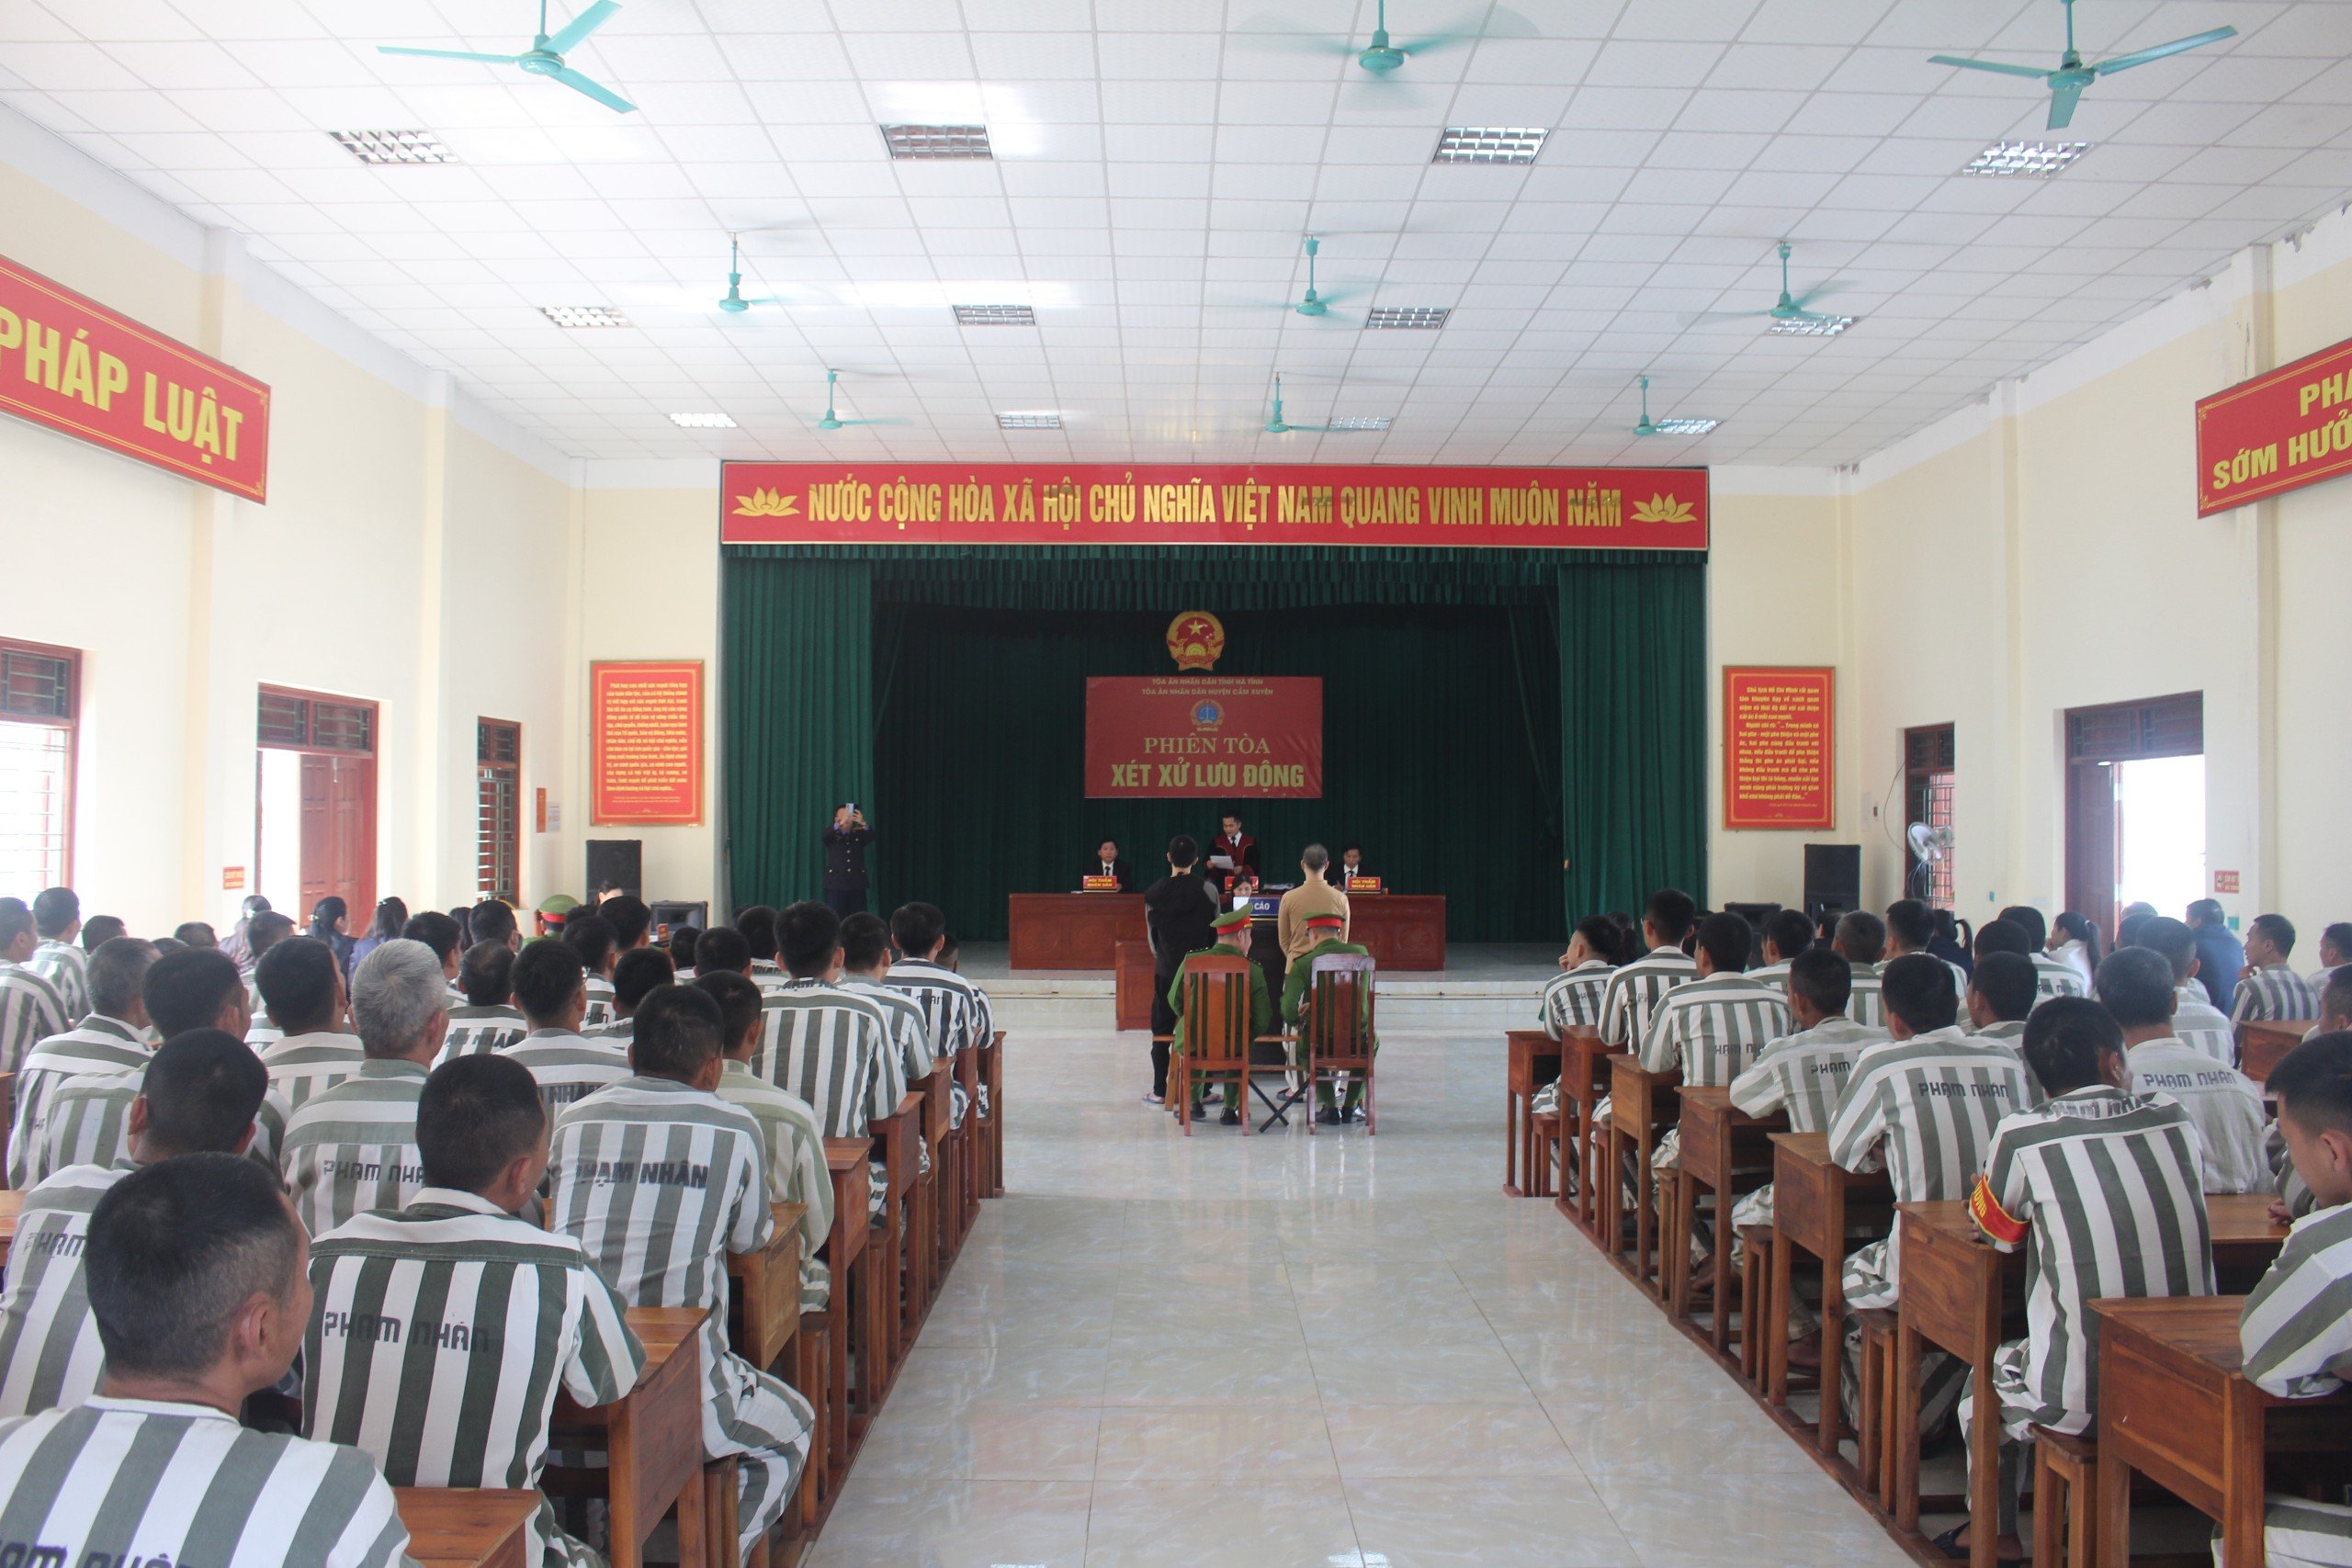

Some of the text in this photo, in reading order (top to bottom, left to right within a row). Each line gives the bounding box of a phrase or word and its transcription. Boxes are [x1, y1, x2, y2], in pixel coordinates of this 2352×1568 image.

[0, 305, 243, 464] PHÁP LUẬT
[2212, 443, 2278, 490] SỚM
[808, 472, 1622, 531] NƯỚC CỘNG HÒA XÃ HỘI CHỦ NGHĨA VIỆT NAM QUANG VINH MUÔN NĂM
[1144, 733, 1270, 754] PHIÊN TÒA
[1111, 757, 1304, 792] XÉT XỬ LƯU ĐỘNG
[1254, 901, 1270, 910] CÁO
[2143, 1074, 2192, 1090] PHẠM
[639, 1160, 708, 1189] NHÂN
